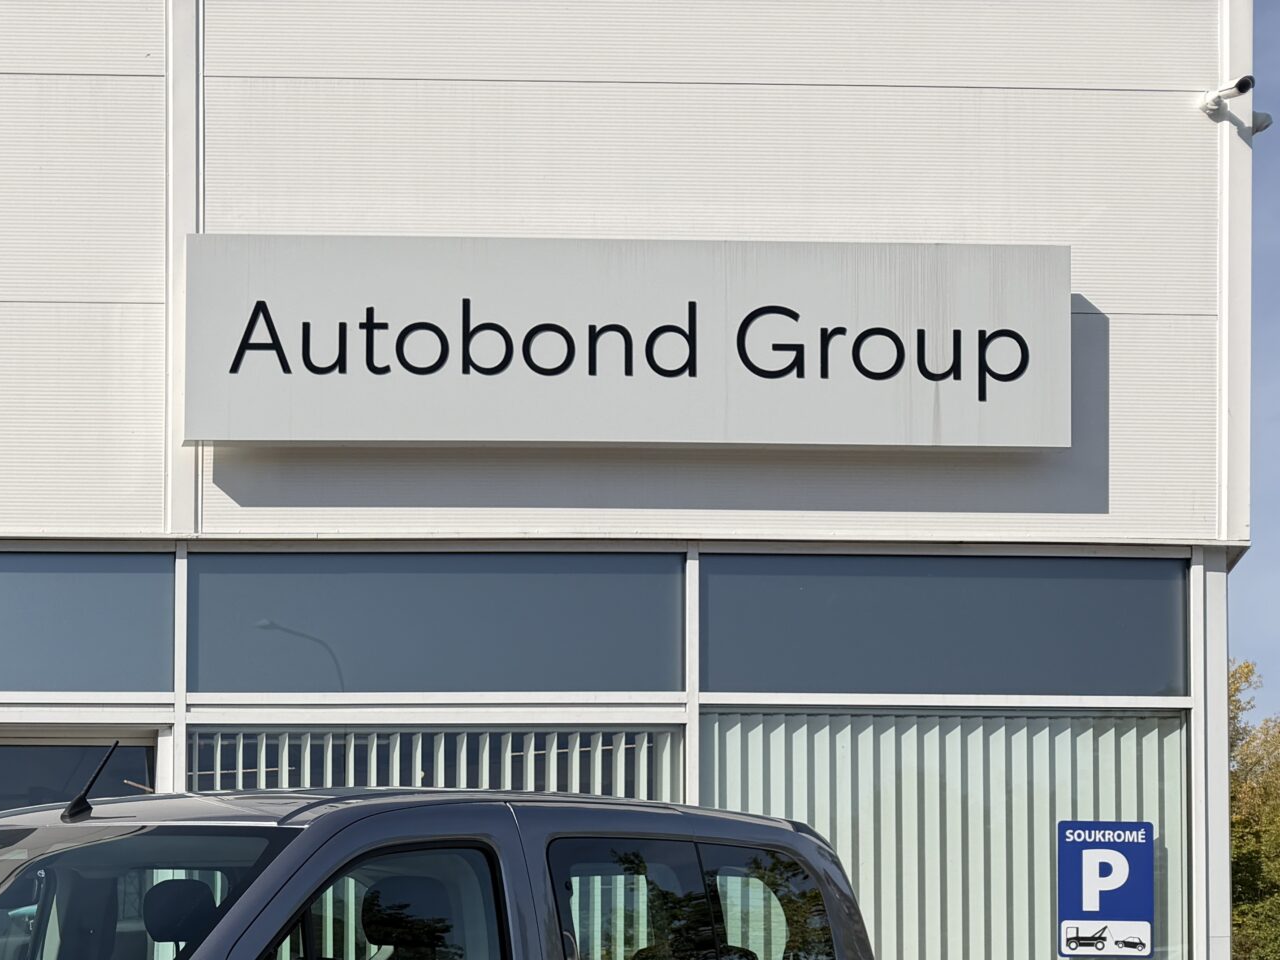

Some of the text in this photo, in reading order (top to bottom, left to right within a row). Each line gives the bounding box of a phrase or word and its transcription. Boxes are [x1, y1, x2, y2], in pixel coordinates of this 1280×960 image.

[228, 297, 1031, 403] Autobond Group
[1065, 828, 1146, 843] SOUKROMÉ
[1082, 848, 1130, 912] P
